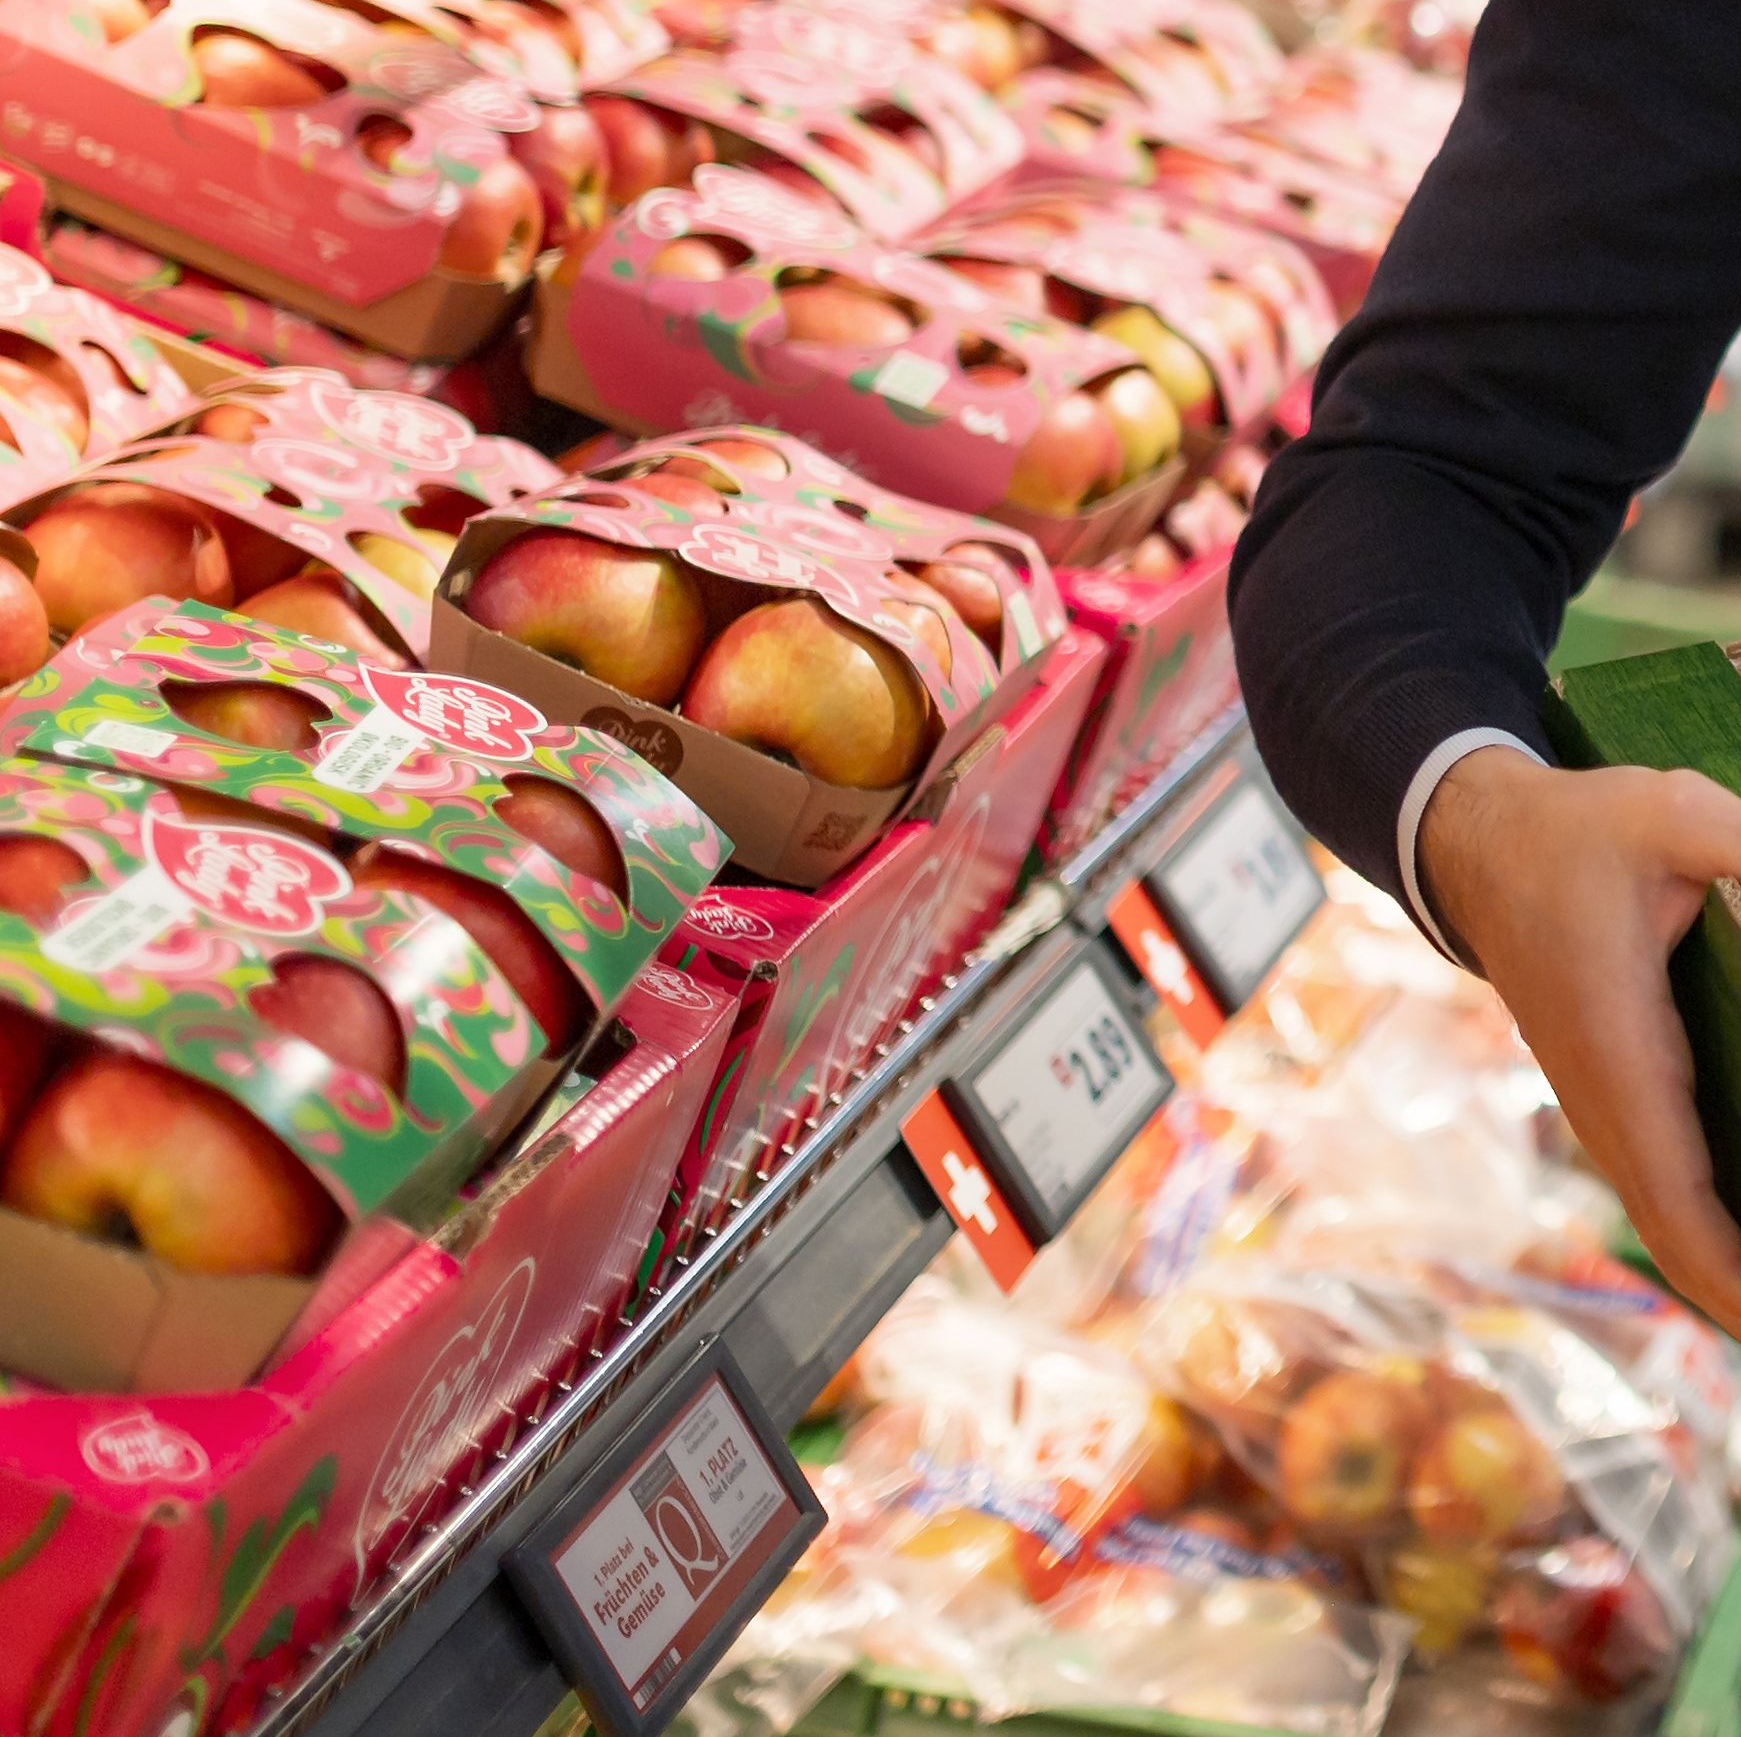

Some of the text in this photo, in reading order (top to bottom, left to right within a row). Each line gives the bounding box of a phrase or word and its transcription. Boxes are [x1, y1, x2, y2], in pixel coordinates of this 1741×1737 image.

[402, 678, 465, 735] Lady
[452, 687, 513, 750] Pink
[699, 1470, 714, 1487] 1.
[708, 1436, 739, 1478] PLATZ
[594, 1537, 634, 1588] 1. Platz bei
[655, 1495, 719, 1587] Q
[594, 1562, 649, 1626] Früchten
[644, 1546, 660, 1568] &
[617, 1582, 665, 1638] Gemüse
